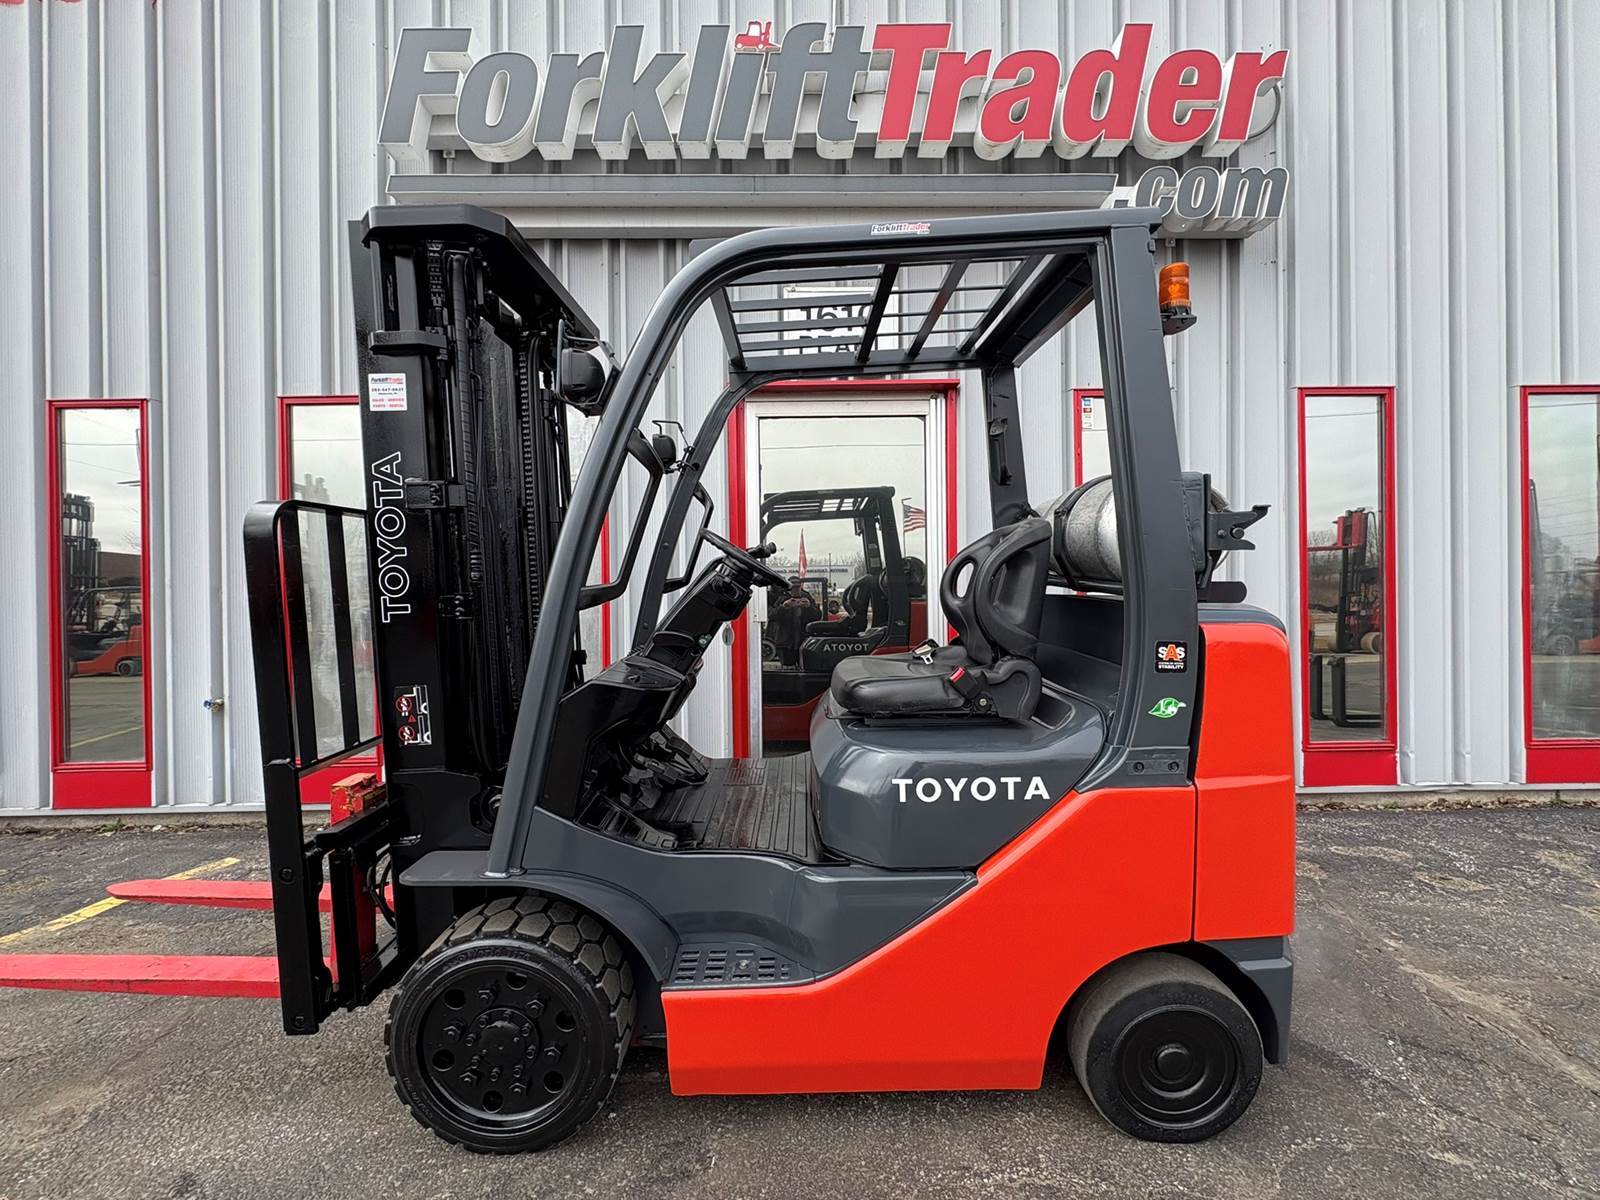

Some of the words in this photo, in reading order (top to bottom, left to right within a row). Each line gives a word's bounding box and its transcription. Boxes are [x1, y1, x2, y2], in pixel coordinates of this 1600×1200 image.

[378, 22, 1290, 146] ForkliftTrader
[371, 451, 411, 623] TOYOTA
[1157, 644, 1186, 661] SAS
[892, 776, 1051, 803] TOYOTA
